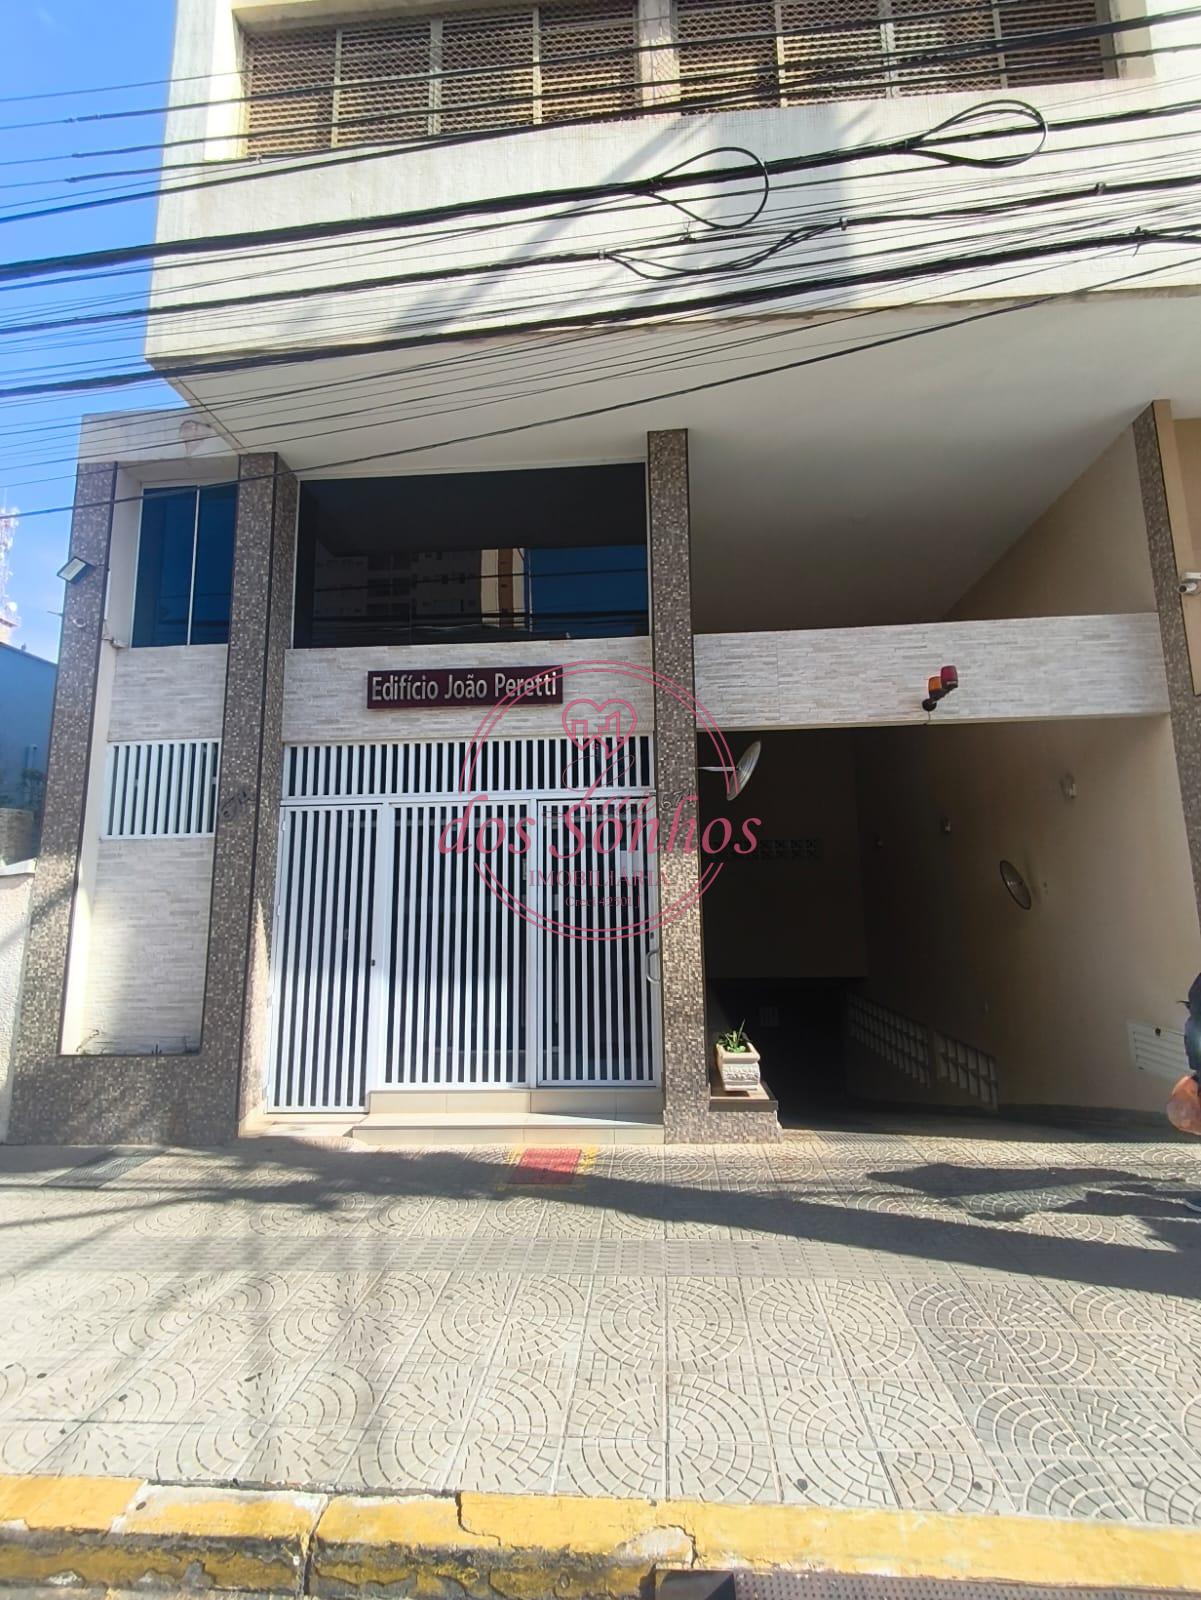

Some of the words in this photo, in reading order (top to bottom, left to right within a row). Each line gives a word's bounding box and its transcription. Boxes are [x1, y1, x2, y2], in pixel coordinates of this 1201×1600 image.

[371, 674, 439, 701] Edifício
[444, 673, 488, 699] João
[494, 672, 557, 697] Peretti
